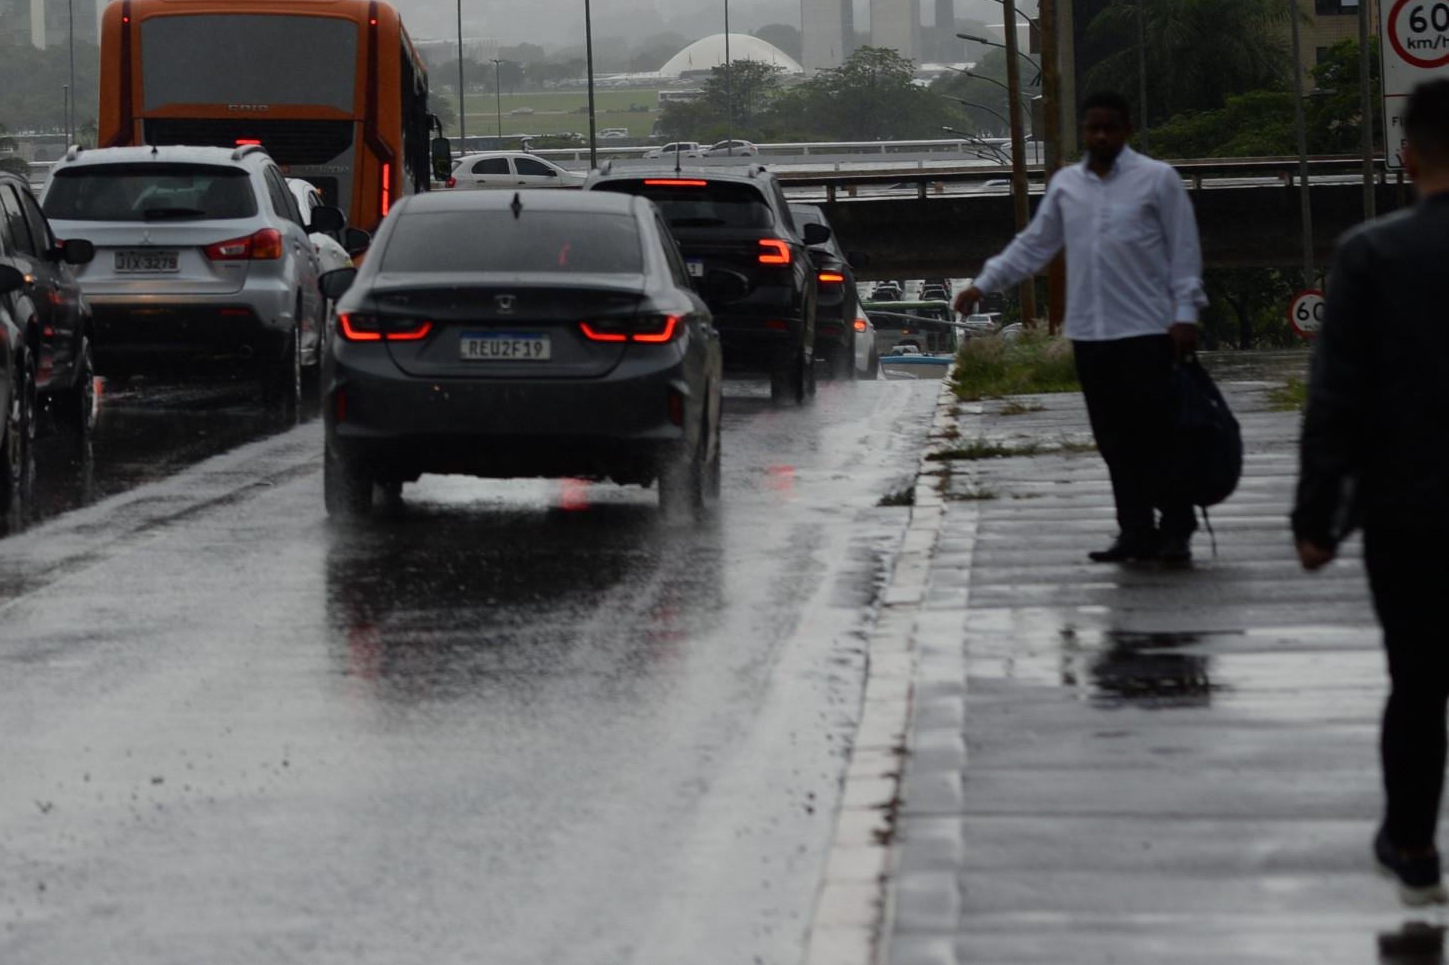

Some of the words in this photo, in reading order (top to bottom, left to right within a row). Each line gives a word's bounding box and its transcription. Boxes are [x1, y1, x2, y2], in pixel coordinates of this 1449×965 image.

[1409, 3, 1449, 33] 60
[1297, 301, 1326, 322] 60
[469, 340, 543, 357] REU2F19
